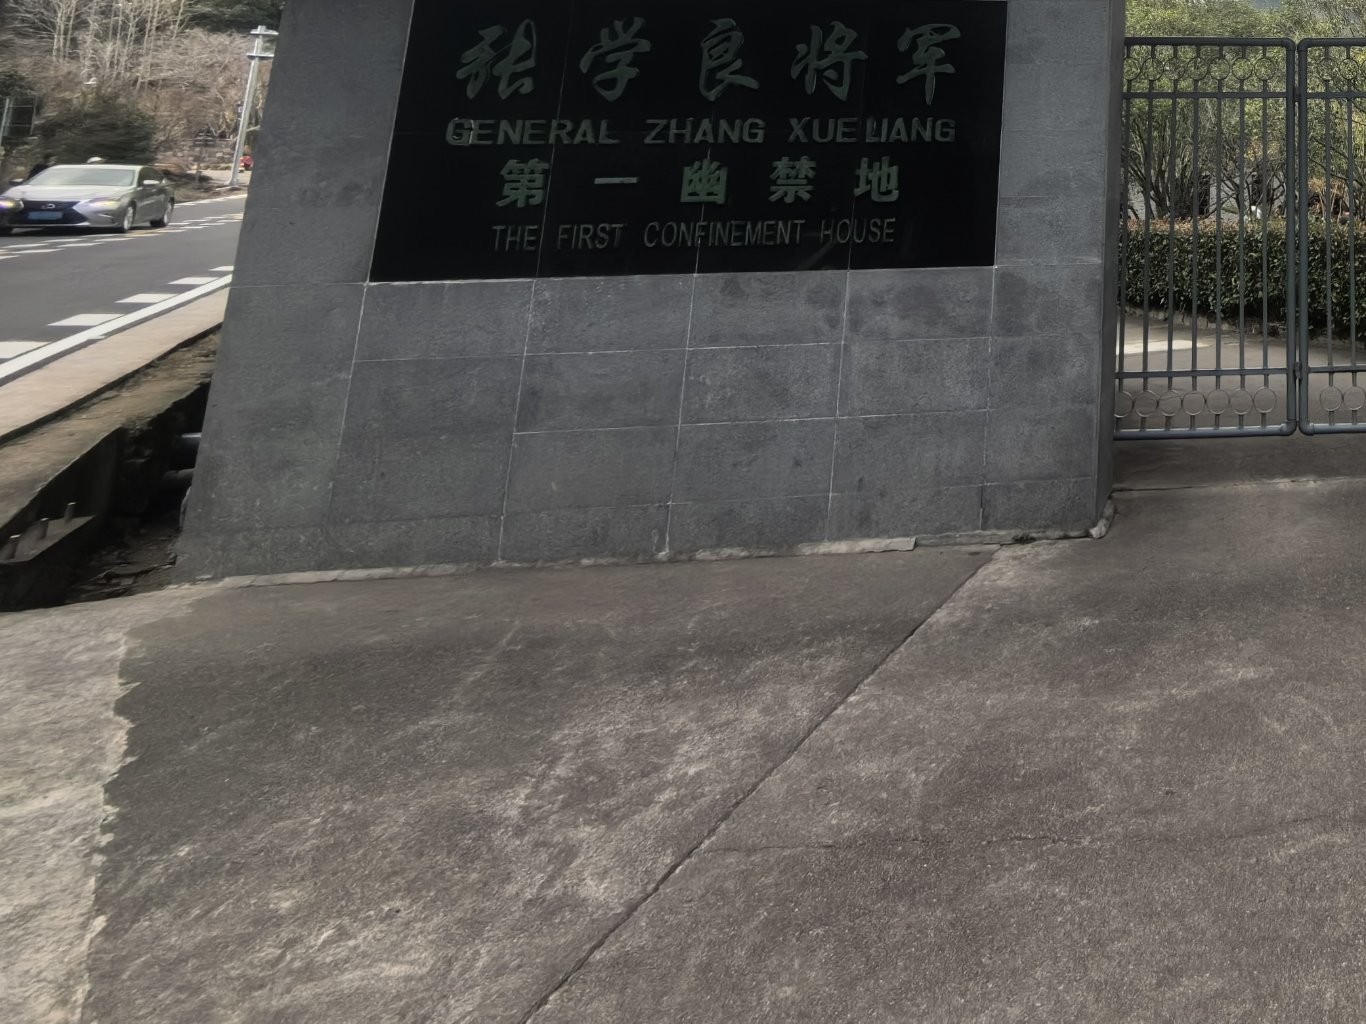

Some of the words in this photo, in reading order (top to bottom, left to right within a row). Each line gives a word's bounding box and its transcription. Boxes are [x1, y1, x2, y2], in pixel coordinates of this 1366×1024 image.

[456, 16, 962, 105] 张学良将军
[445, 117, 620, 147] GENERAL
[644, 117, 765, 144] ZHANG
[496, 156, 900, 208] 第一幽禁地
[492, 225, 539, 252] THE
[557, 223, 628, 250] FIRST
[644, 219, 806, 248] CONFINEMENT
[819, 217, 897, 245] HOUSE
